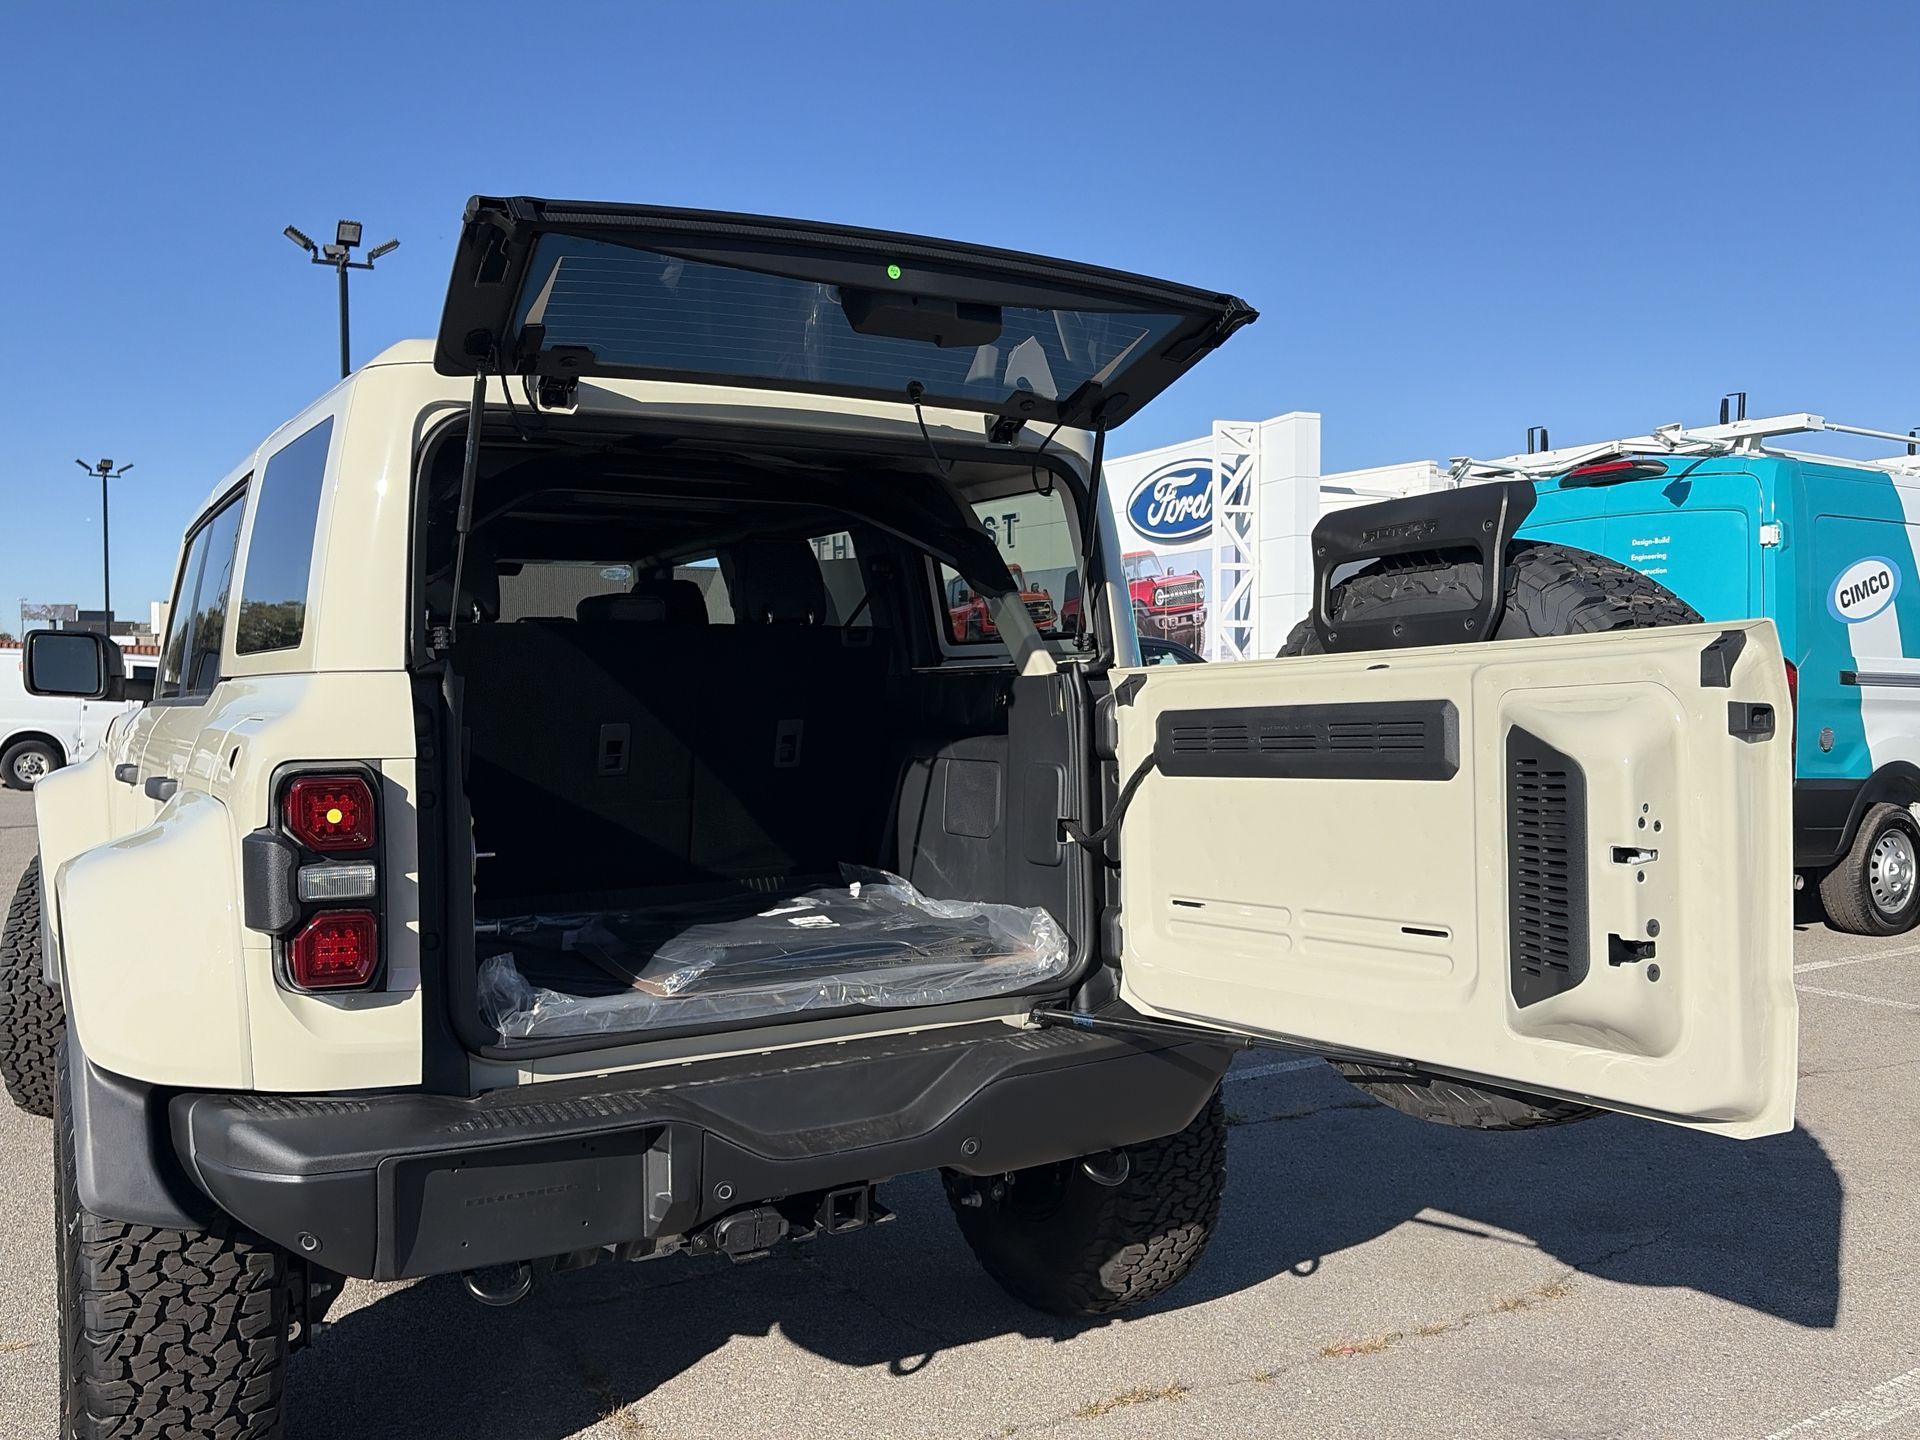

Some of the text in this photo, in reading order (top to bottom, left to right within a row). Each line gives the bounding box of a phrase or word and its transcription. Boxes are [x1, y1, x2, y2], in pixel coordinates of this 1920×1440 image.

[1147, 473, 1213, 526] Ford
[1632, 536, 1670, 547] Design-Build
[1631, 551, 1667, 563] Engineering
[1638, 566, 1668, 576] struction
[1840, 571, 1890, 609] CIMCO
